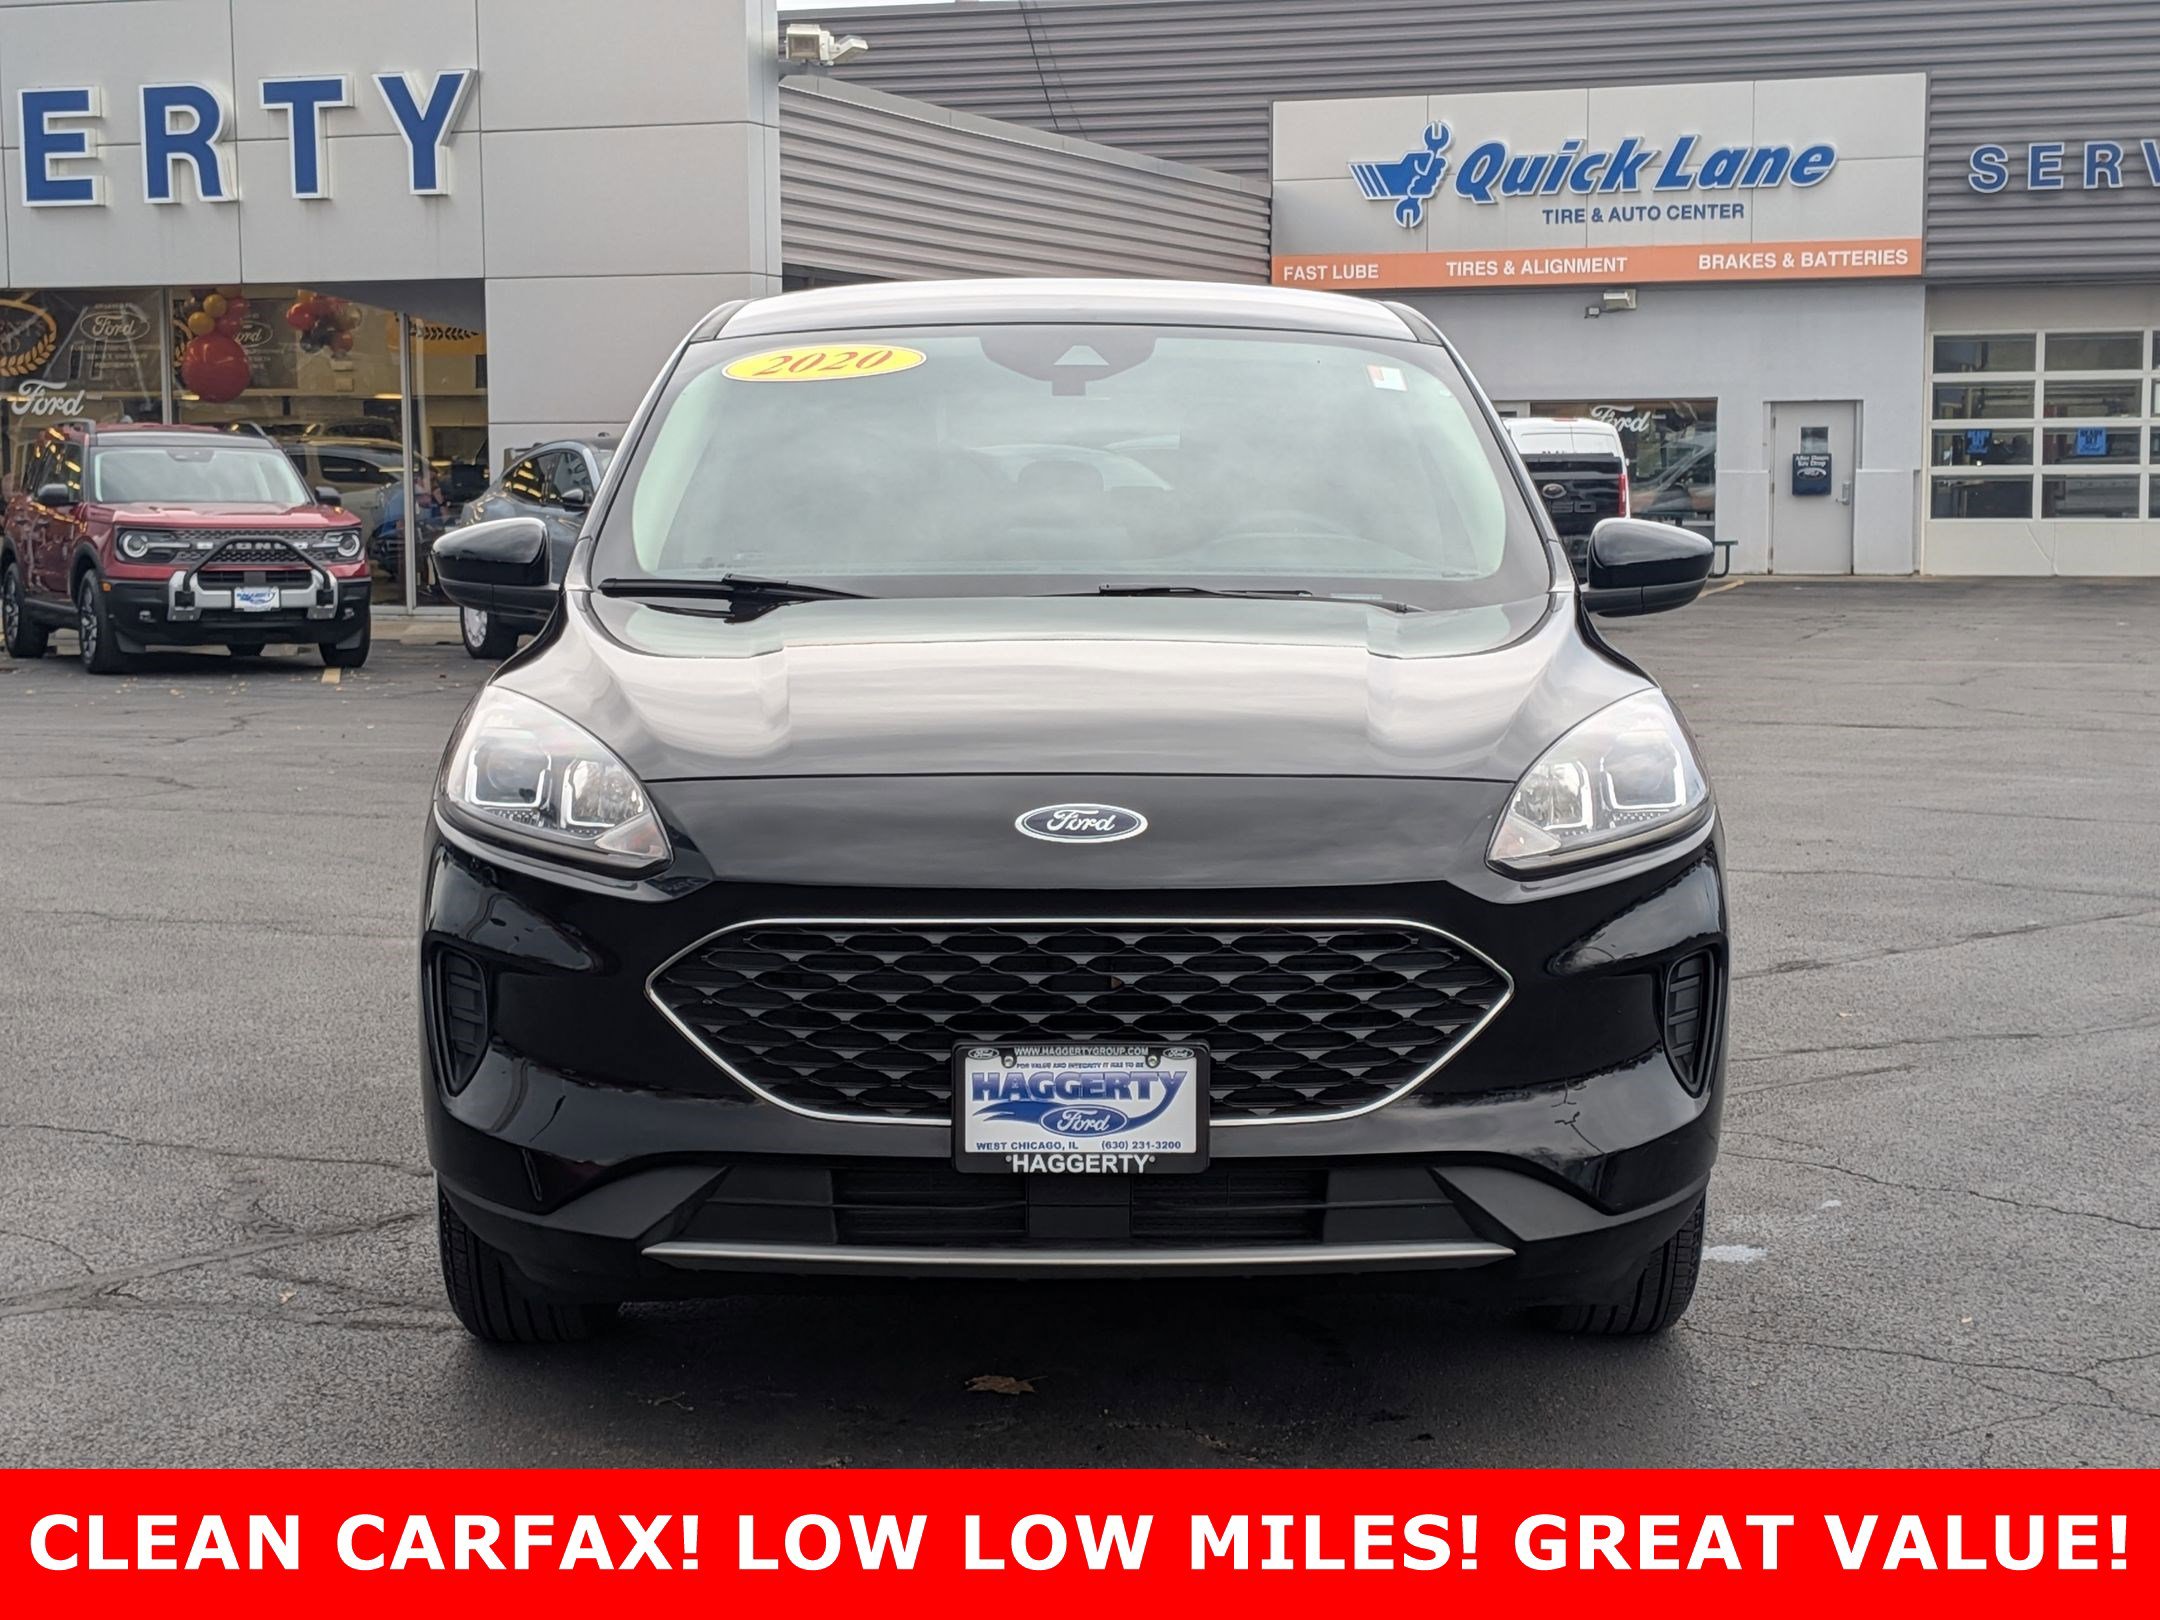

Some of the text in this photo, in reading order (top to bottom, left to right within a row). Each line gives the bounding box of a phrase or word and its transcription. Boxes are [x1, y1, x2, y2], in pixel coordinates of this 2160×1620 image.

[18, 68, 477, 207] ERTY
[1455, 134, 1838, 205] Quick Lane
[1542, 203, 1745, 225] TIRE & AUTO CENTER
[1446, 257, 1628, 277] TIRES & ALIGNMENT
[1698, 248, 1909, 270] BRAKES & BATTERIES
[1283, 264, 1380, 281] FAST LUBE
[92, 315, 136, 336] Ford
[752, 350, 894, 377] 2020
[11, 379, 86, 416] Ford
[1046, 809, 1117, 832] Ford
[1014, 1046, 1149, 1056] WWW.HAGGERTYGROUP.COM
[972, 1071, 1187, 1101] HAGGERTY
[1056, 1108, 1111, 1132] Ford
[976, 1140, 1182, 1152] WEST CHICAGO, IL (630) 231-3200
[1012, 1154, 1150, 1173] HAGGERTY
